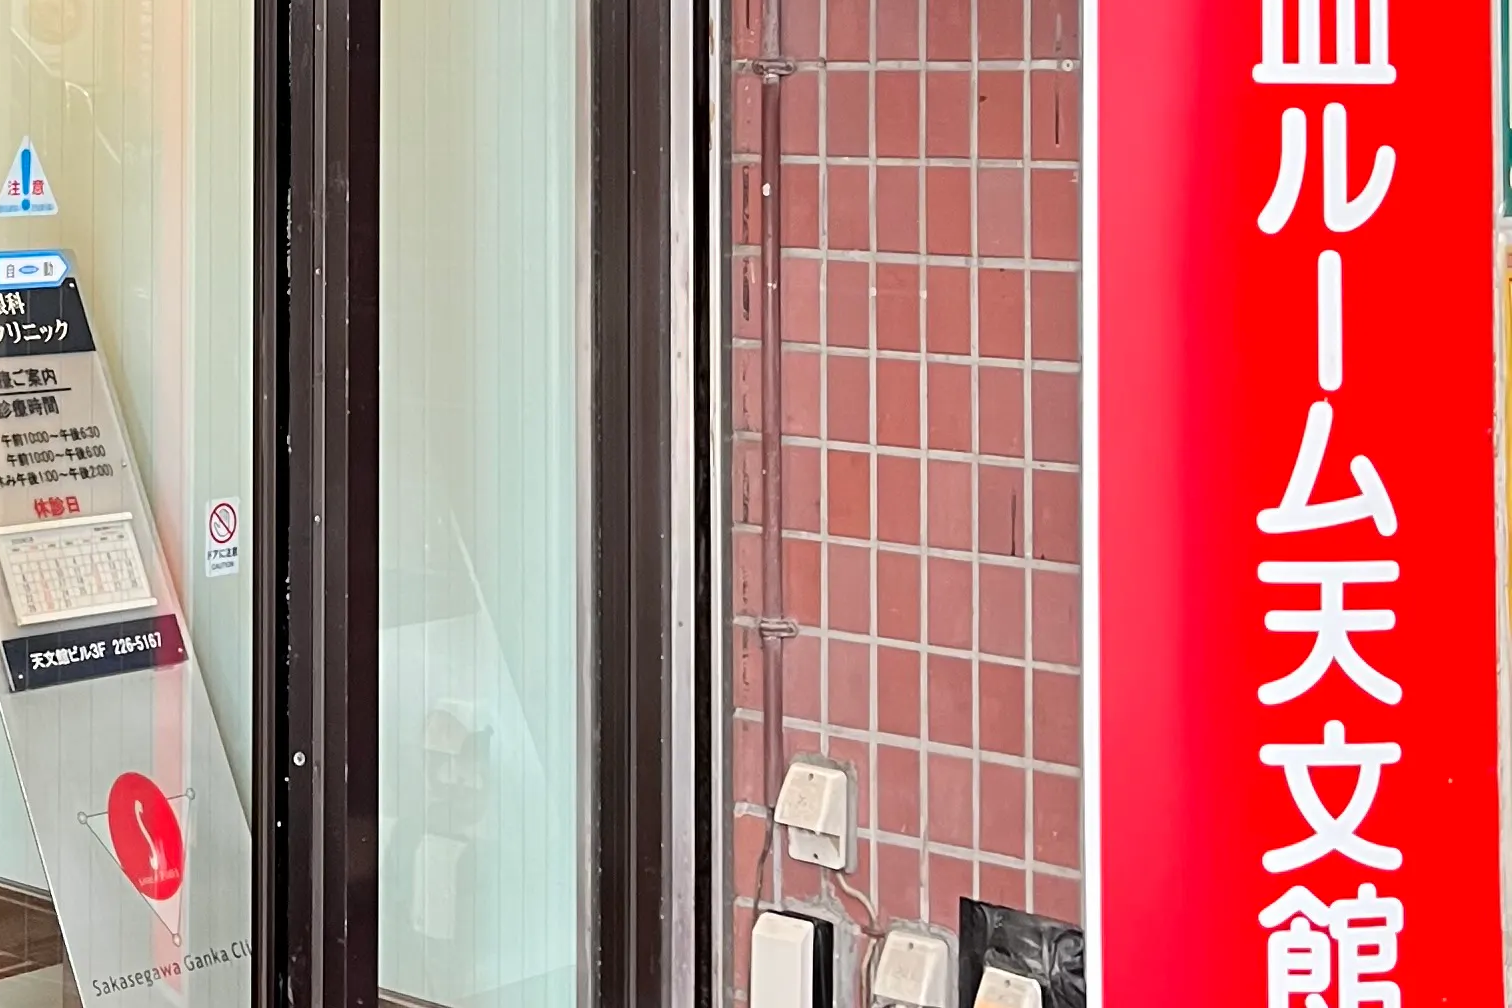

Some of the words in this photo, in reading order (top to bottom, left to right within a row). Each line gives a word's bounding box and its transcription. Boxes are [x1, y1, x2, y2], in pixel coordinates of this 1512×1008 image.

[111, 631, 162, 655] 226-5167
[92, 961, 182, 997] Sakasegawa
[183, 947, 230, 972] Ganka
